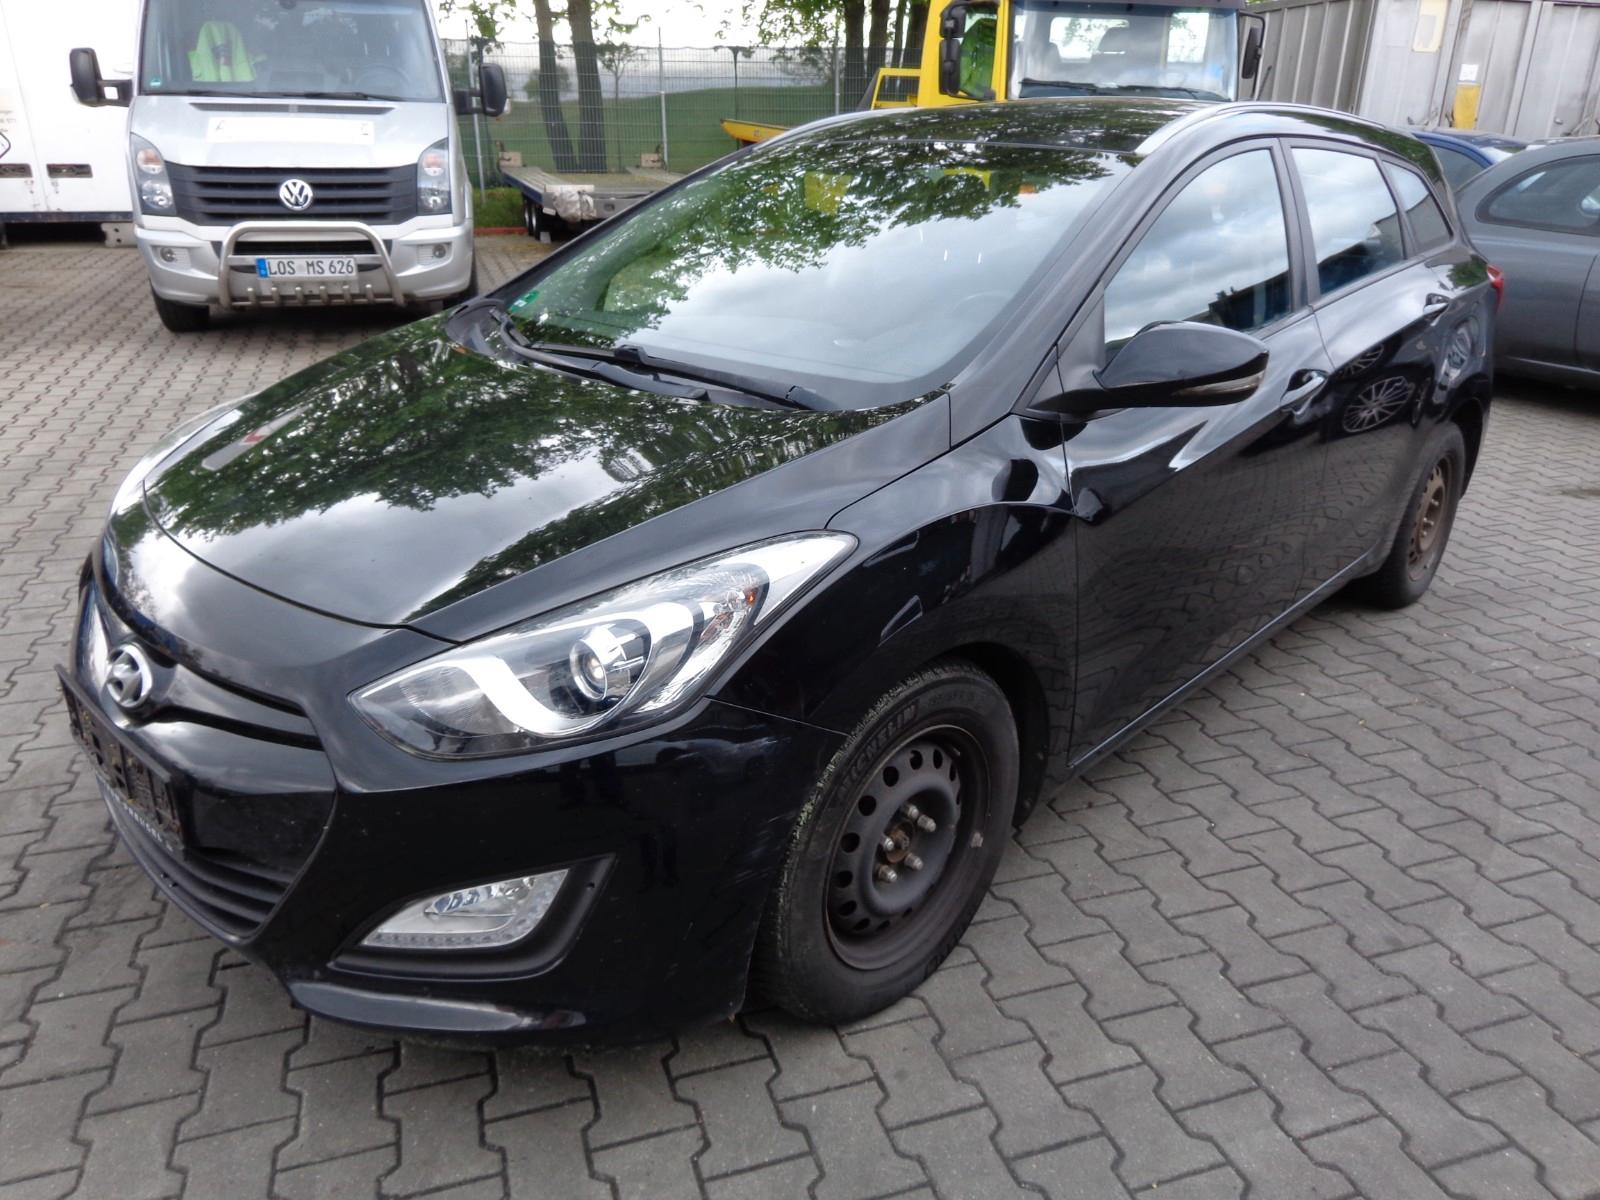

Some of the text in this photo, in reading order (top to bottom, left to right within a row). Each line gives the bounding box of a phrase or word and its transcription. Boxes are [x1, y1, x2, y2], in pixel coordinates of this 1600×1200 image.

[267, 260, 354, 275] LOS MS 626
